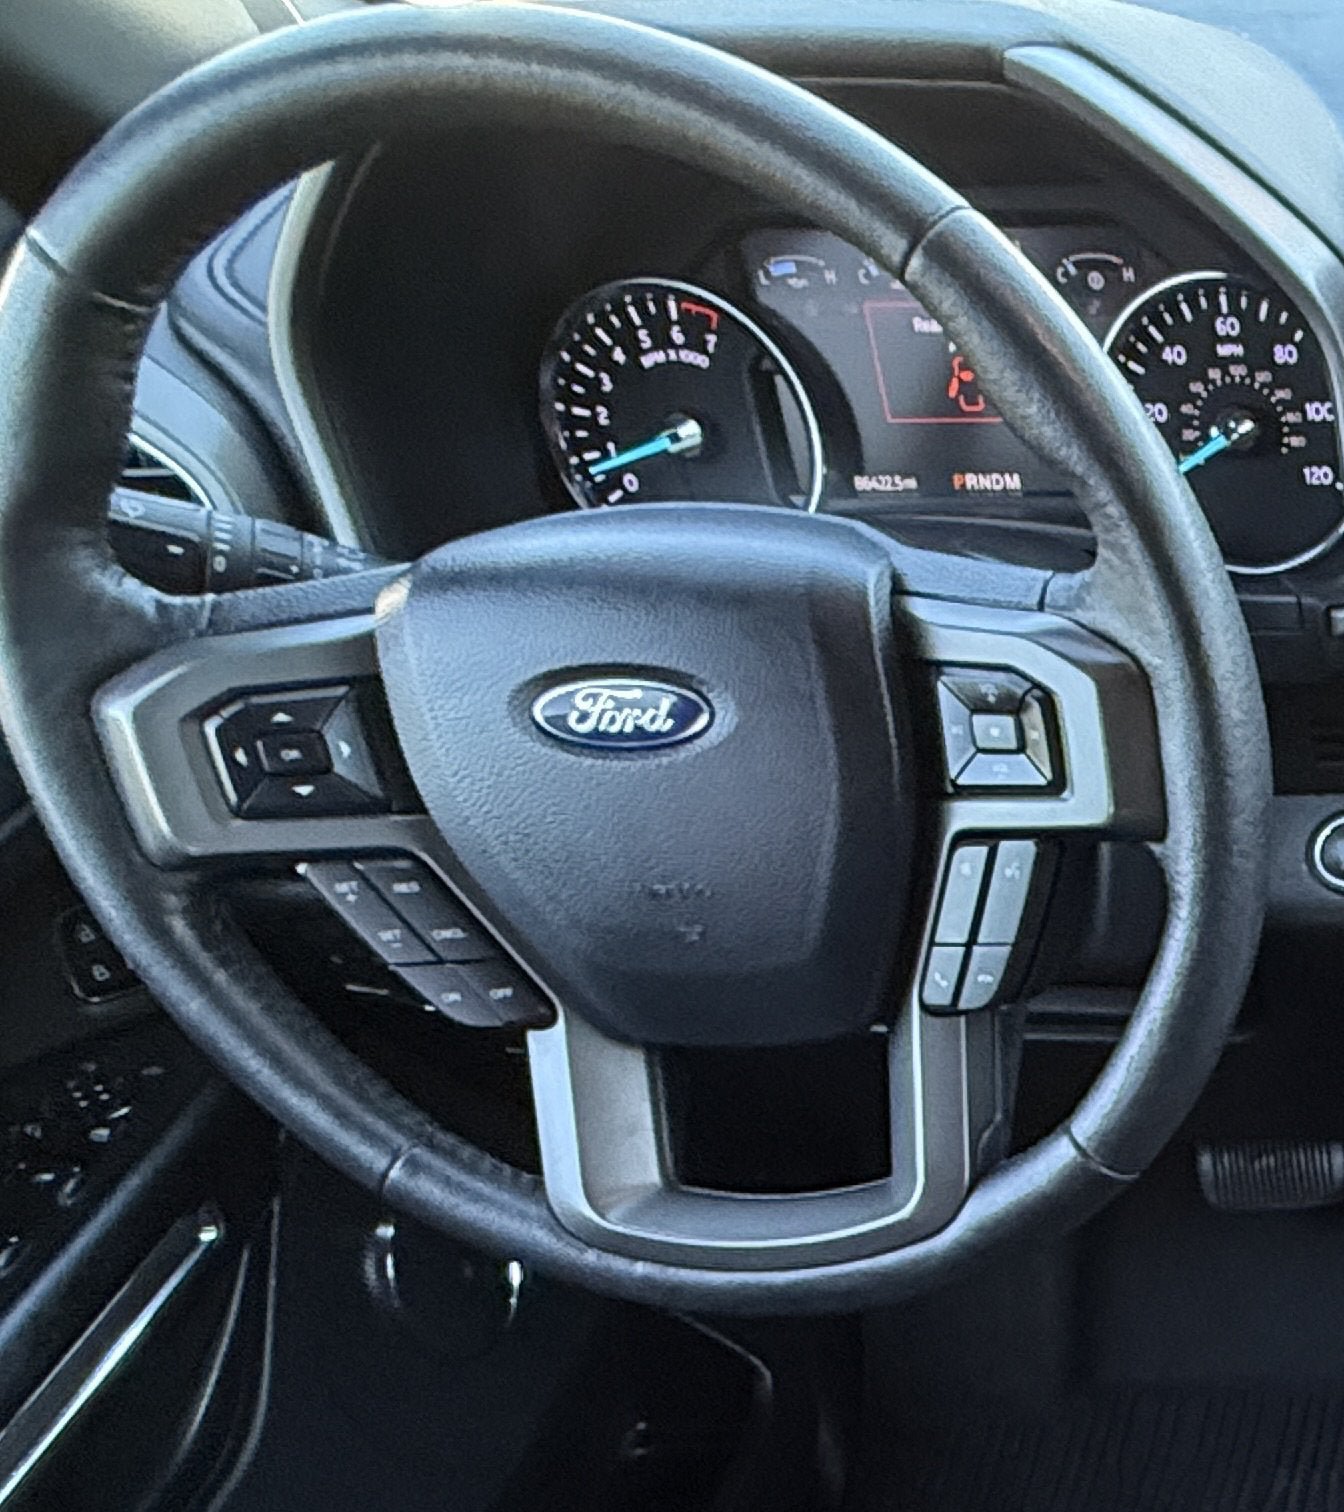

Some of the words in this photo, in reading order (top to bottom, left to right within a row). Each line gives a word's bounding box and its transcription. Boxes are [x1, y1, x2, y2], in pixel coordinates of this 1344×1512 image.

[670, 325, 685, 346] 6
[1215, 316, 1241, 336] 60
[637, 328, 652, 349] 5
[704, 333, 718, 353] 7
[611, 346, 627, 366] 4
[1161, 344, 1188, 365] 40
[1273, 344, 1299, 365] 80
[599, 372, 613, 393] 3
[596, 405, 610, 426] 2
[622, 473, 639, 493] 0
[1302, 465, 1334, 486] 120
[566, 687, 678, 735] Ford
